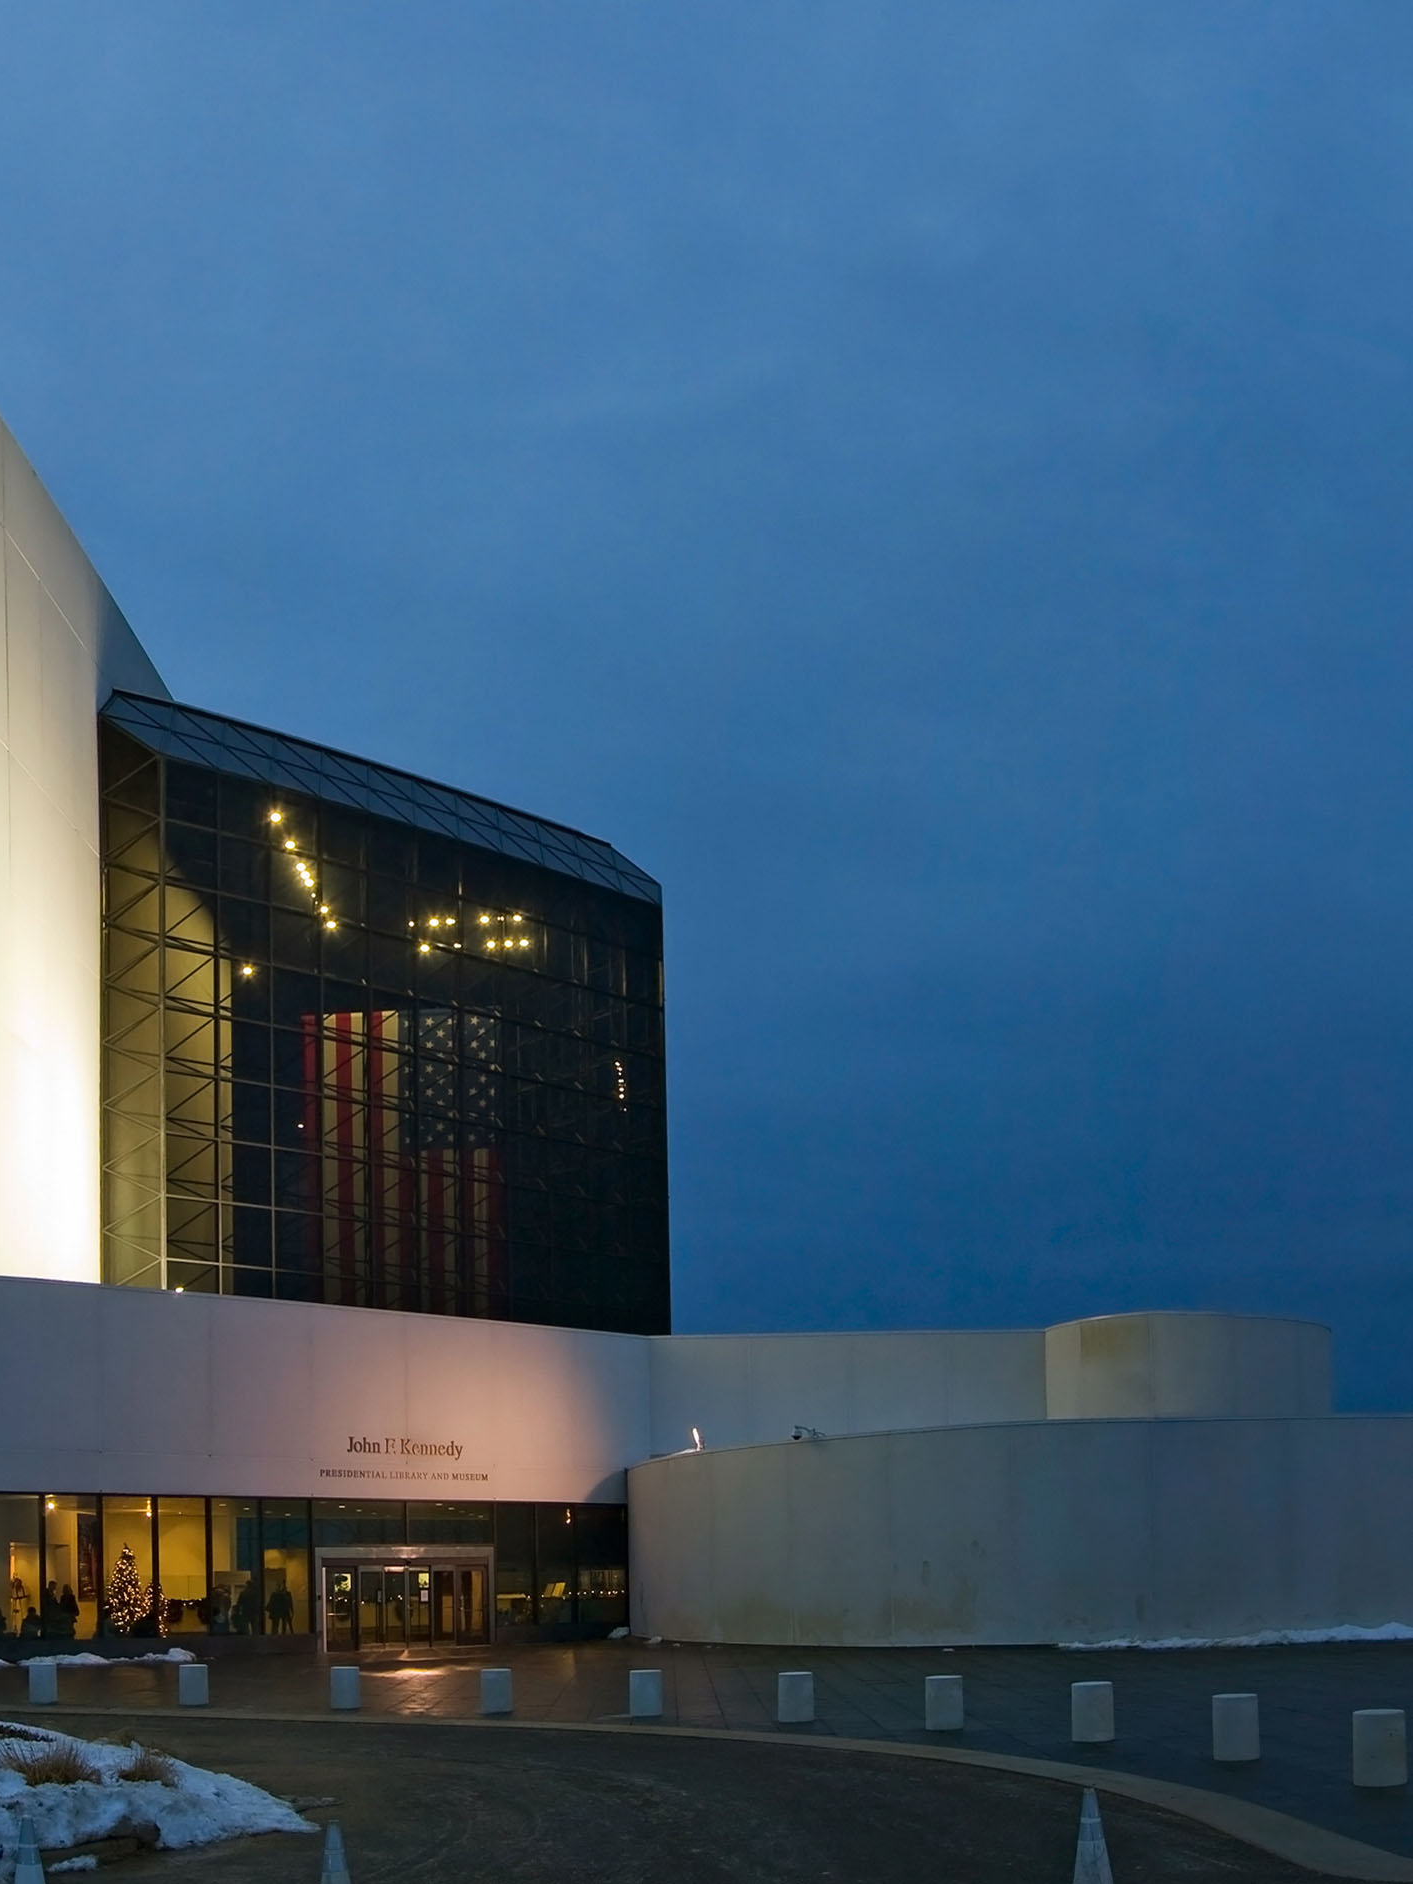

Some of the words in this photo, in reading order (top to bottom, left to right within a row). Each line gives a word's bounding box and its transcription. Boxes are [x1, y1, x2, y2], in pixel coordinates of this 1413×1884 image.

[347, 1436, 381, 1454] John
[385, 1438, 396, 1454] F.
[400, 1438, 463, 1461] Kennedy
[320, 1468, 387, 1480] PRESIDENTIAL
[389, 1471, 428, 1480] LIBRARY
[431, 1472, 449, 1480] AND
[452, 1472, 489, 1481] MUSEUM
